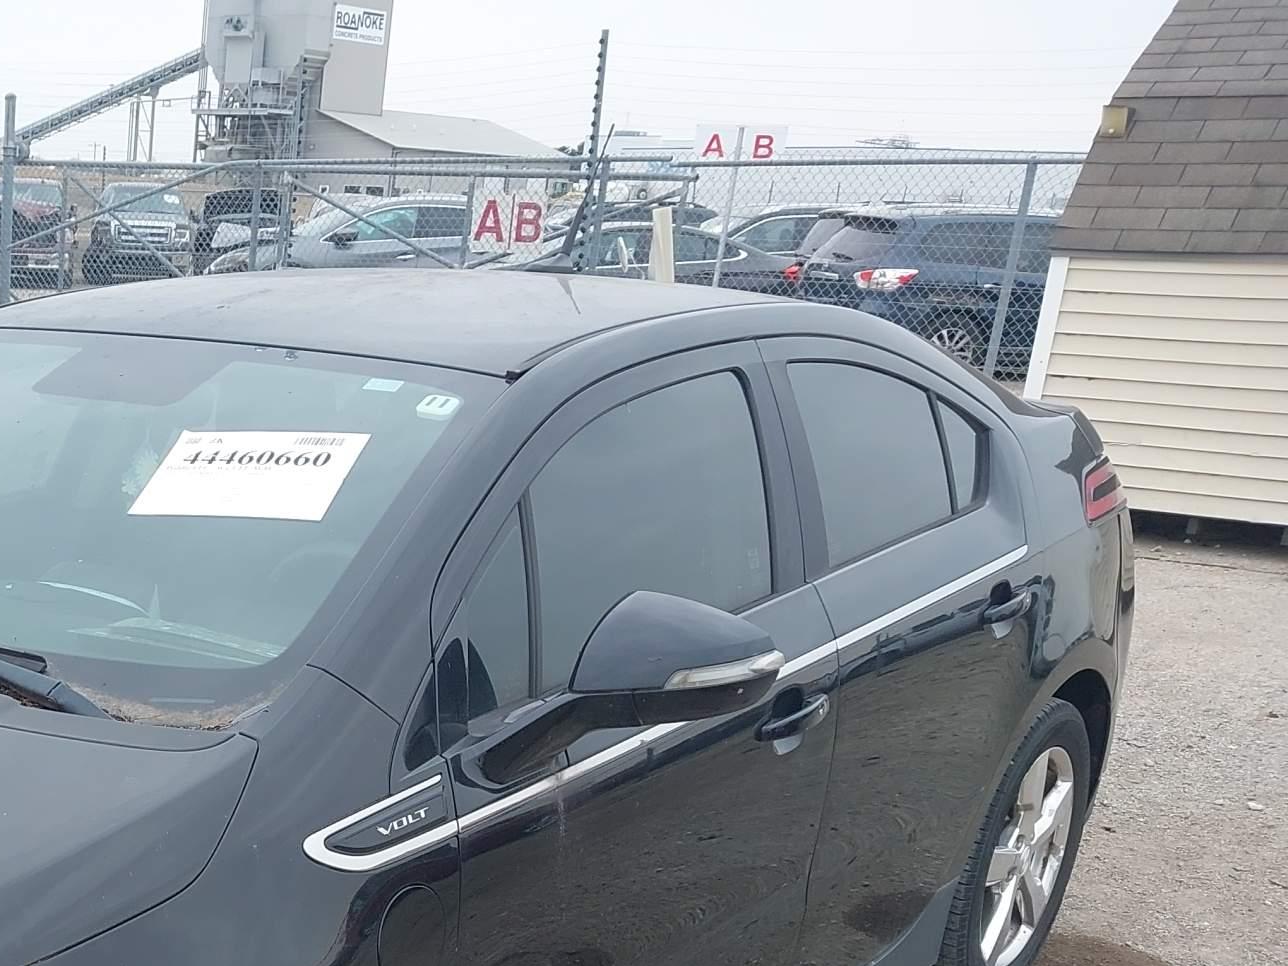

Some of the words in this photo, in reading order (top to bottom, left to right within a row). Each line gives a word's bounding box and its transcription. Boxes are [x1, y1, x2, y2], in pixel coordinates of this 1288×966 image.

[336, 11, 385, 31] ROANOKE
[335, 31, 358, 40] CONCRETE
[359, 33, 383, 43] PRODUCTS
[702, 133, 724, 158] A
[752, 134, 774, 159] B
[473, 199, 504, 243] A
[513, 201, 543, 243] B
[183, 449, 332, 467] 44460660
[376, 806, 429, 836] VOLT
